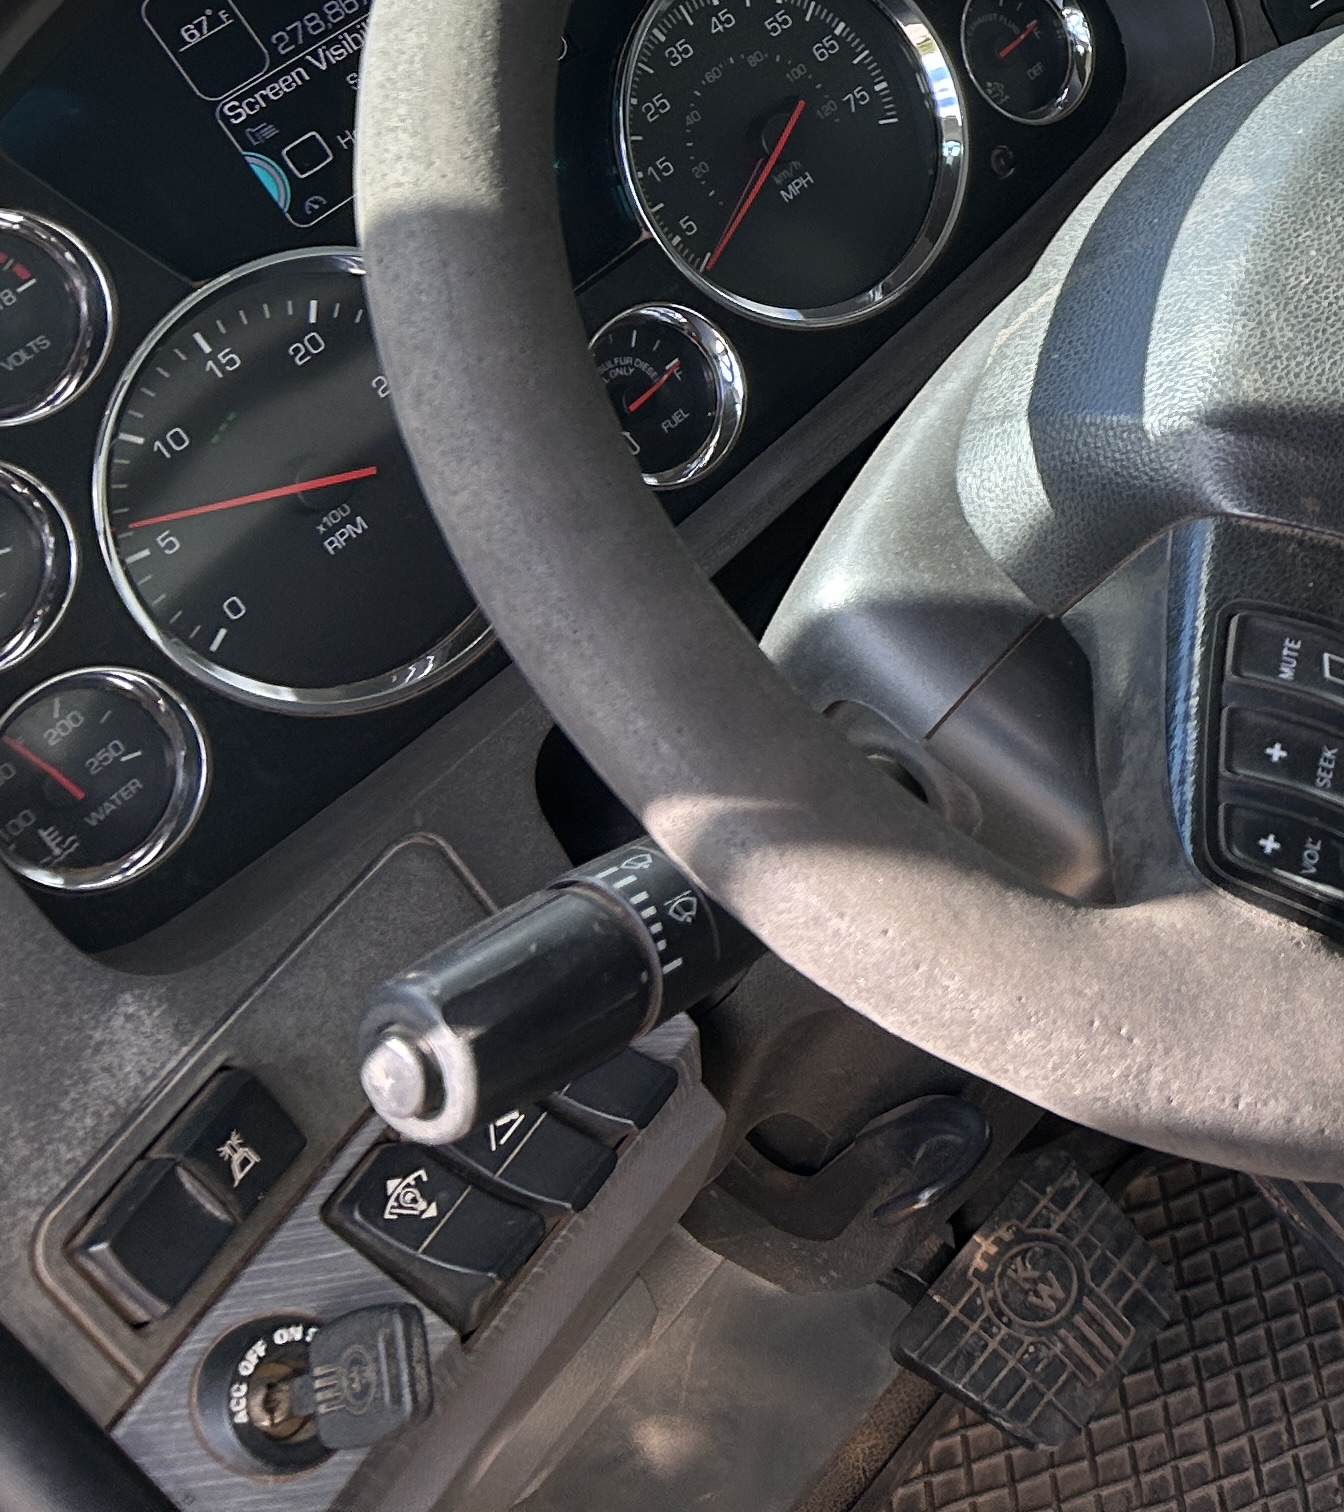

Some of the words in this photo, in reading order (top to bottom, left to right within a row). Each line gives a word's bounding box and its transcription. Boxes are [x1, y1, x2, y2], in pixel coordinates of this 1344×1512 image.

[710, 8, 737, 35] 45
[764, 9, 793, 37] 55
[664, 38, 694, 68] 35
[747, 50, 764, 67] 80
[812, 34, 840, 62] 65
[704, 66, 723, 84] 60
[785, 63, 807, 83] 100
[1027, 61, 1044, 80] DEF
[222, 66, 311, 125] Screen
[641, 93, 671, 123] 25
[816, 99, 838, 120] 120
[842, 86, 870, 113] 75
[685, 109, 702, 127] 40
[647, 155, 675, 183] 15
[691, 160, 710, 179] 20
[772, 160, 803, 186] km/h
[779, 171, 815, 203] MPH
[679, 215, 698, 236] 5
[0, 334, 51, 372] VOLTS
[204, 347, 242, 378] 15
[287, 332, 326, 366] 20
[370, 375, 391, 398] 2
[609, 366, 635, 379] ONLY
[673, 368, 683, 381] F
[661, 407, 690, 434] FUEL
[152, 427, 191, 459] 10
[315, 502, 352, 535] x100
[156, 530, 181, 555] 5
[323, 516, 369, 555] RPM
[222, 596, 247, 620] 0
[1278, 637, 1302, 681] MUTE
[43, 710, 85, 746] 200
[85, 739, 126, 776] 250
[1314, 744, 1339, 790] SEEK
[83, 778, 144, 827] WATER
[1301, 839, 1323, 875] VOL
[273, 1323, 304, 1345] ON
[238, 1337, 268, 1377] OFF
[229, 1381, 250, 1424] ACC
